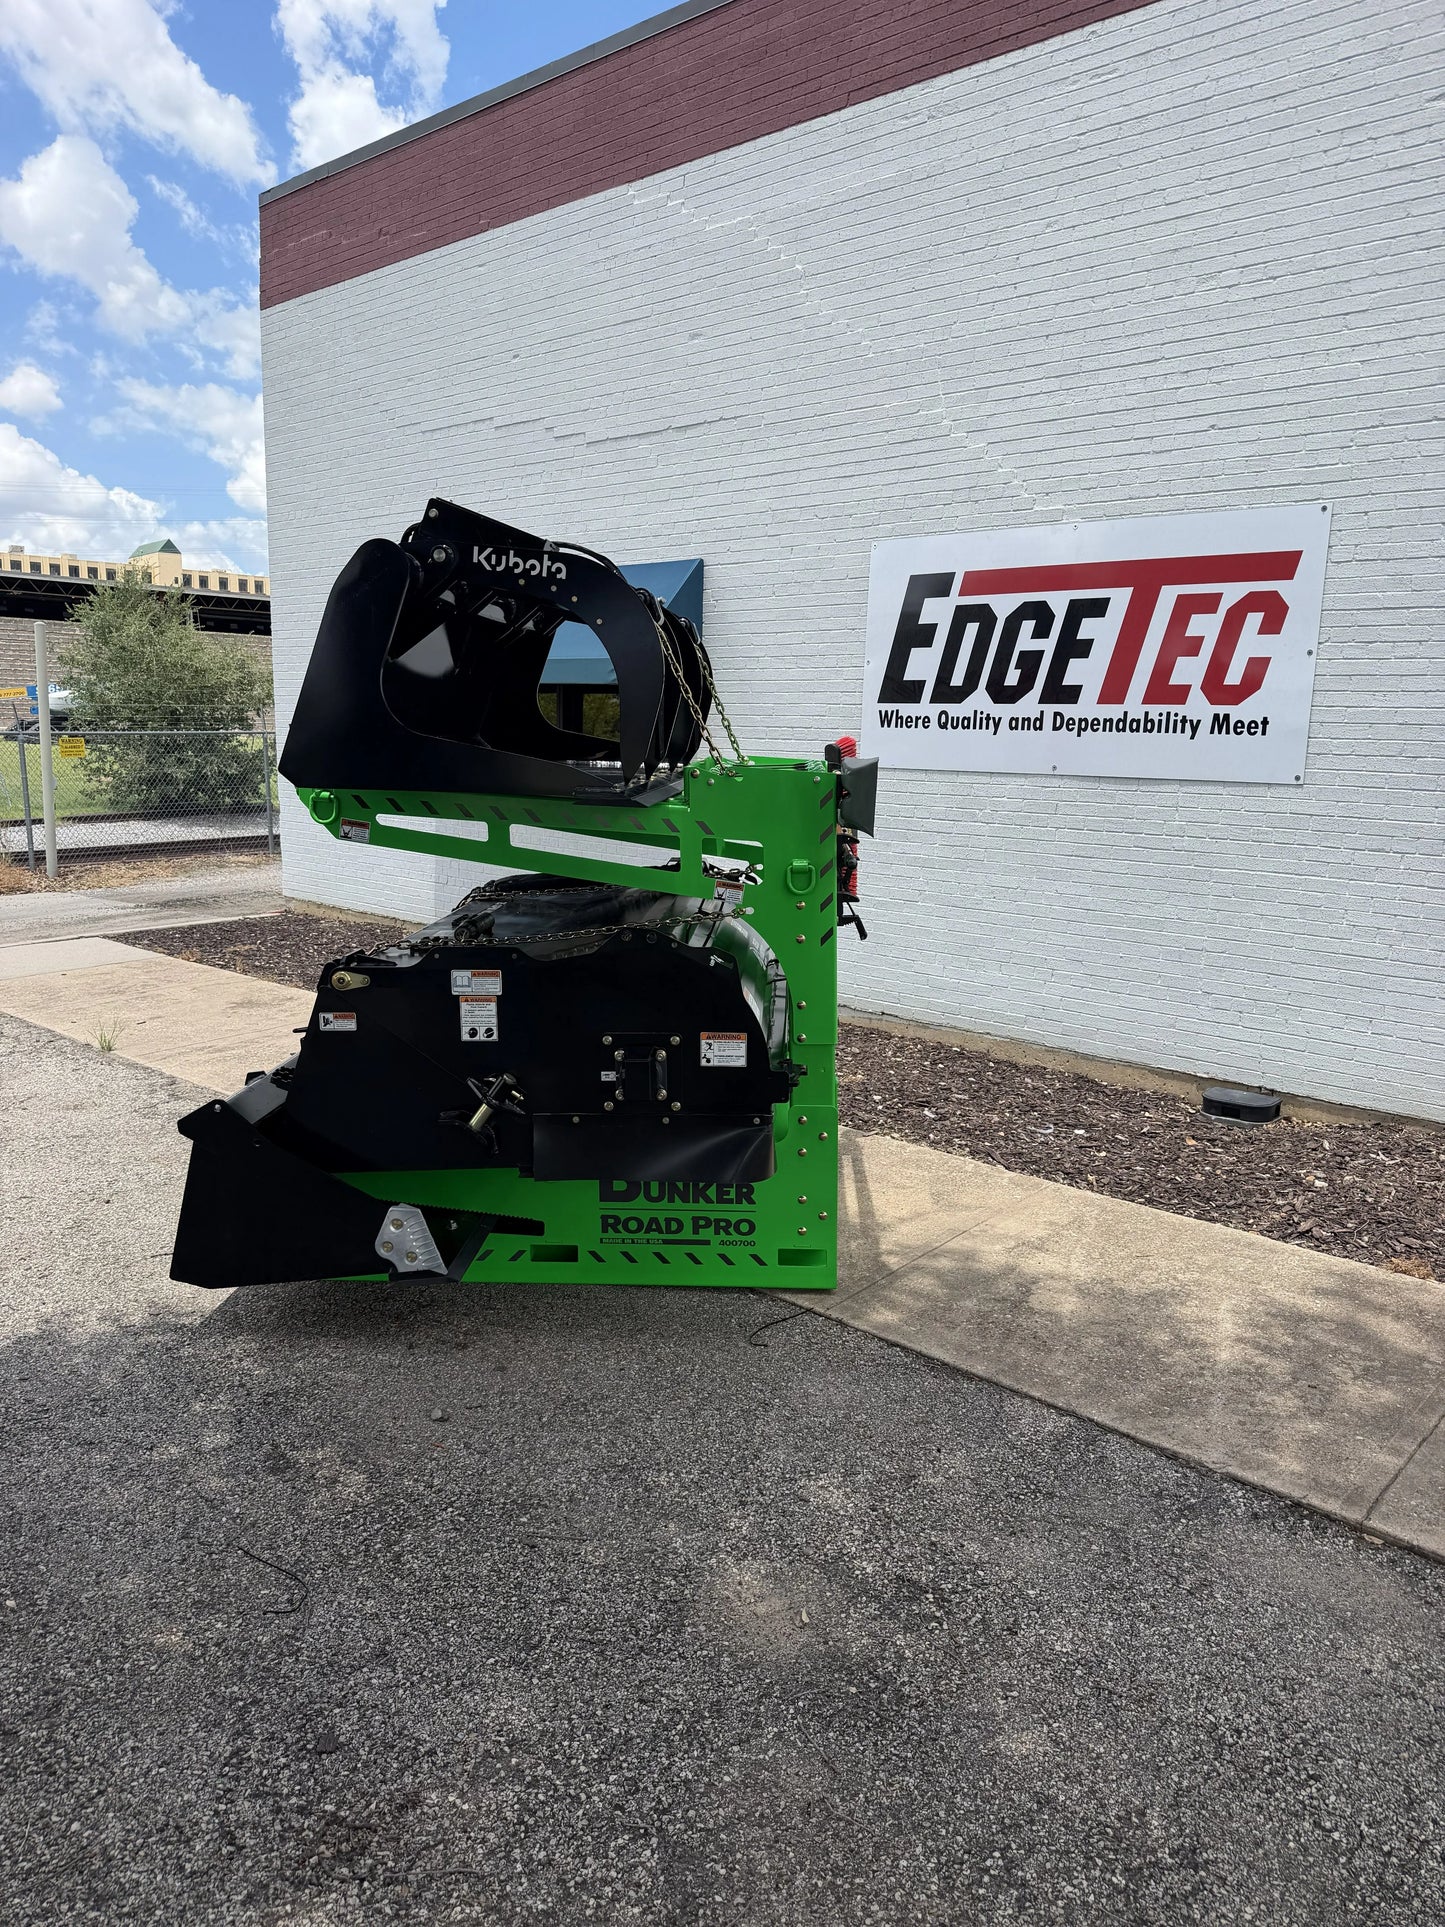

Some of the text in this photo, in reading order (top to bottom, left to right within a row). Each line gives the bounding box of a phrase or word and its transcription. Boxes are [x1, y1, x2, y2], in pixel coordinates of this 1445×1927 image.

[473, 545, 567, 580] Kubota
[878, 709, 1270, 740] Where Quality and Dependability Meet
[600, 1214, 756, 1236] ROAD PRO
[718, 1239, 756, 1247] 400700
